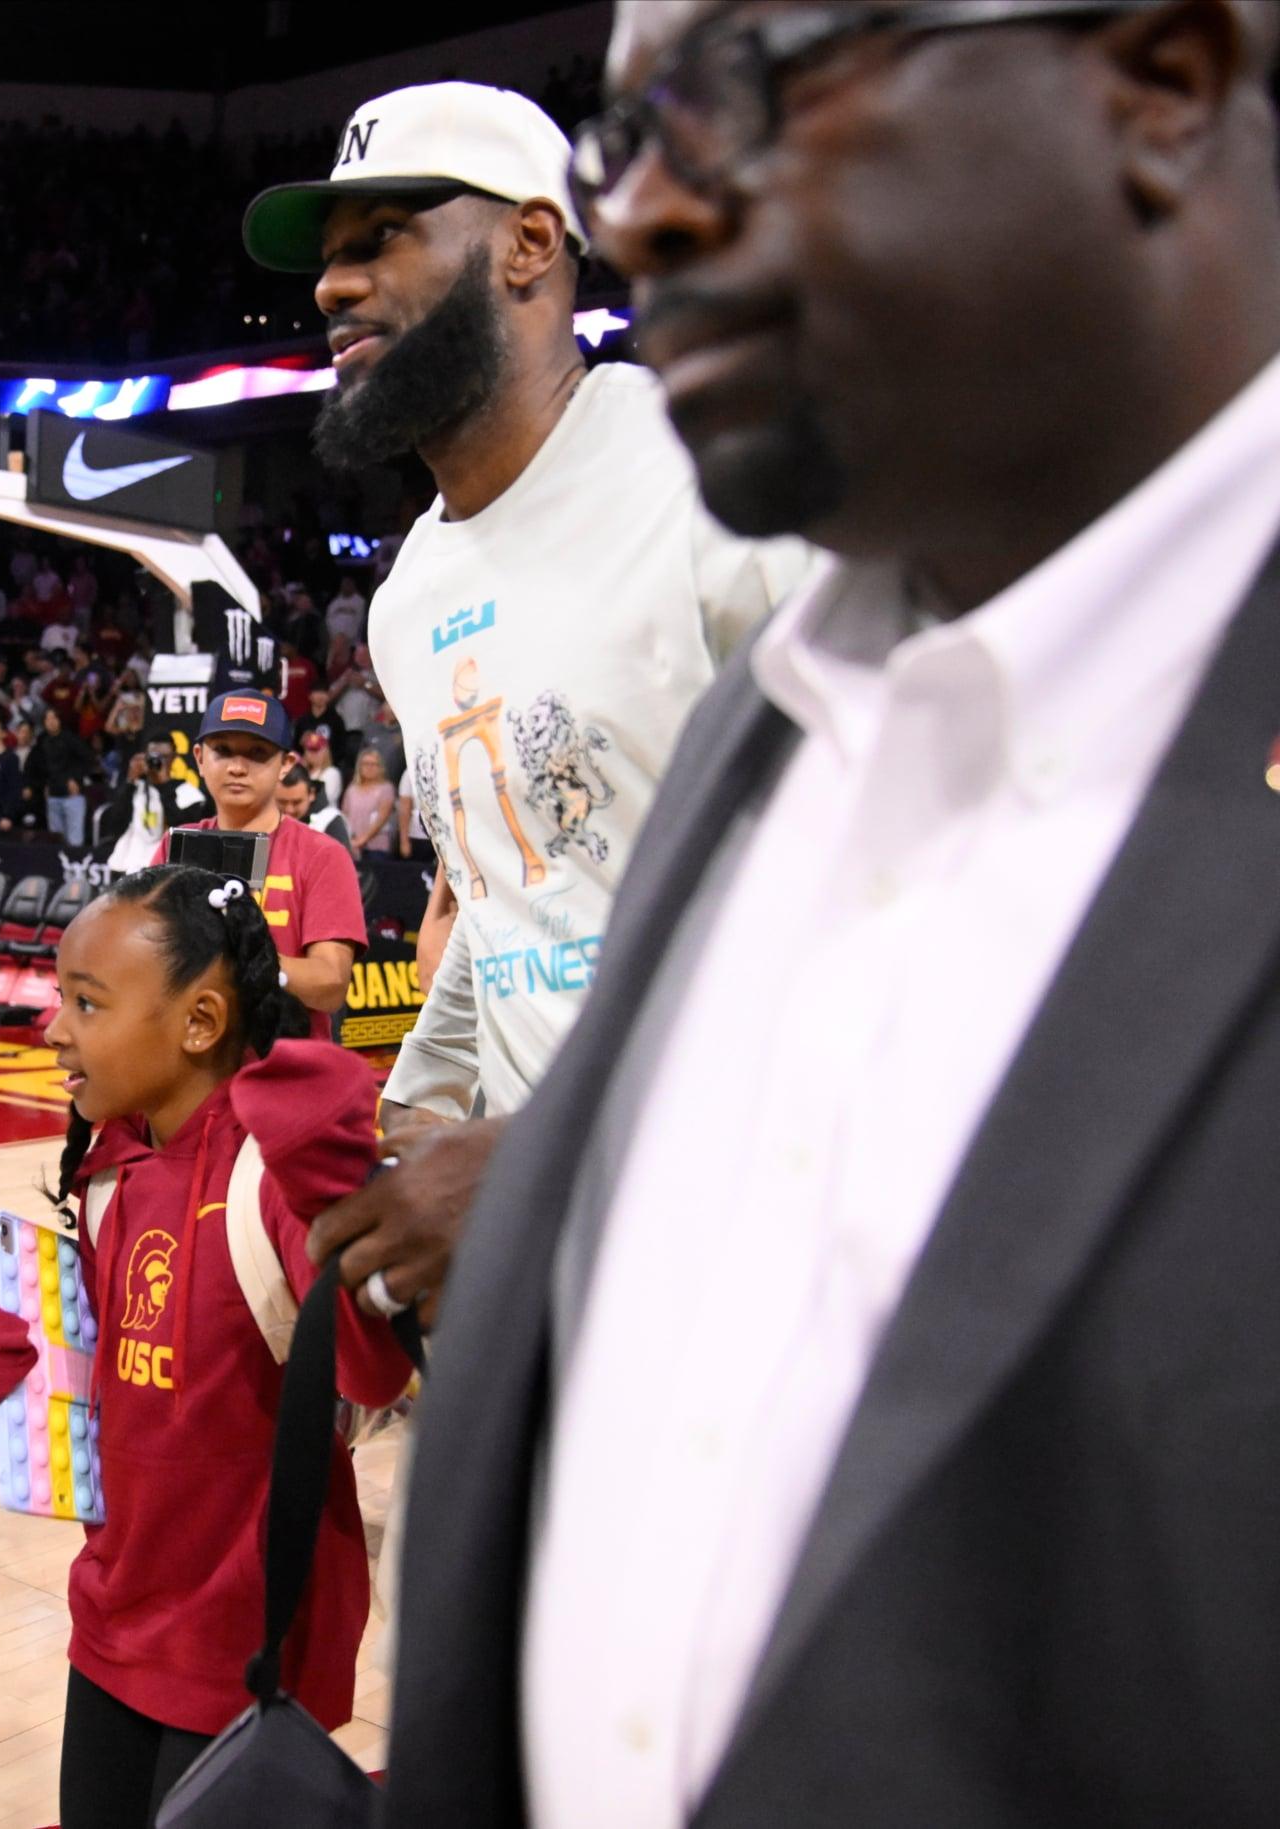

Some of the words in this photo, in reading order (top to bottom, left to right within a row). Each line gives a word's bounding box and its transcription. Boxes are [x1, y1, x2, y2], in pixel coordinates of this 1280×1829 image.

[334, 114, 380, 166] N
[147, 686, 208, 714] YETI
[117, 1336, 175, 1390] USC
